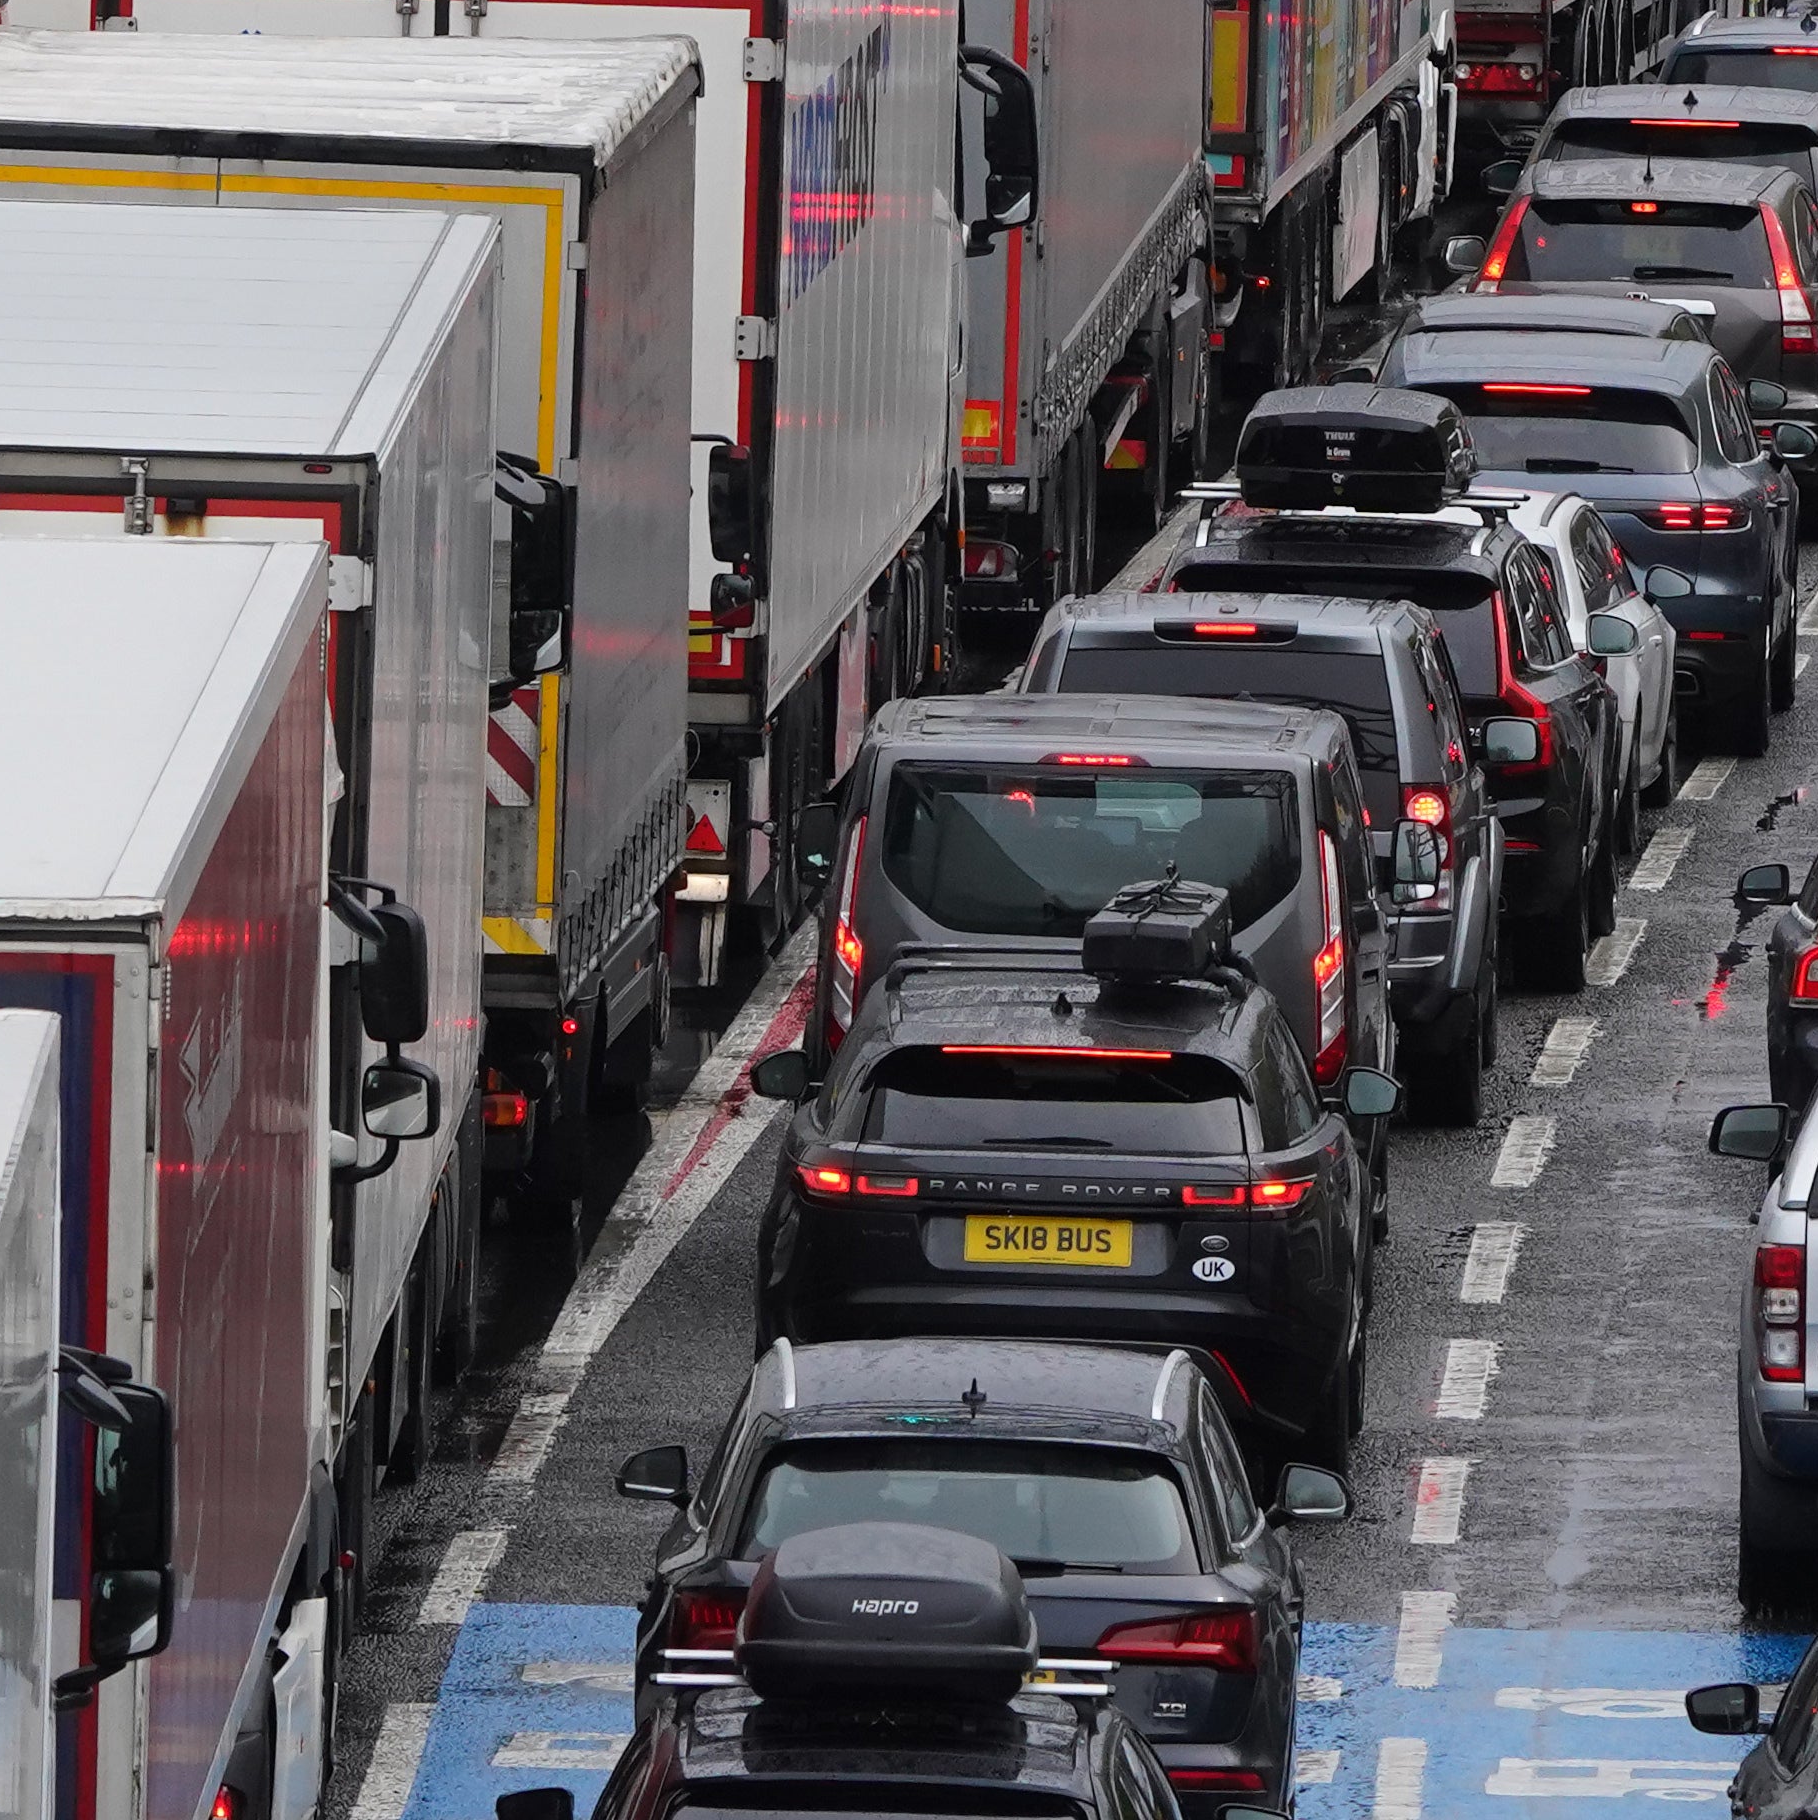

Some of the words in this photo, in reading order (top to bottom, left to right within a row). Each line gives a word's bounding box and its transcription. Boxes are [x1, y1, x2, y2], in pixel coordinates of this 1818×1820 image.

[1324, 431, 1356, 441] THULE
[929, 1179, 1042, 1194] RANGE
[1062, 1184, 1172, 1198] ROVER
[984, 1224, 1049, 1253] SK18
[1056, 1226, 1114, 1255] BUS
[1202, 1261, 1226, 1278] UK
